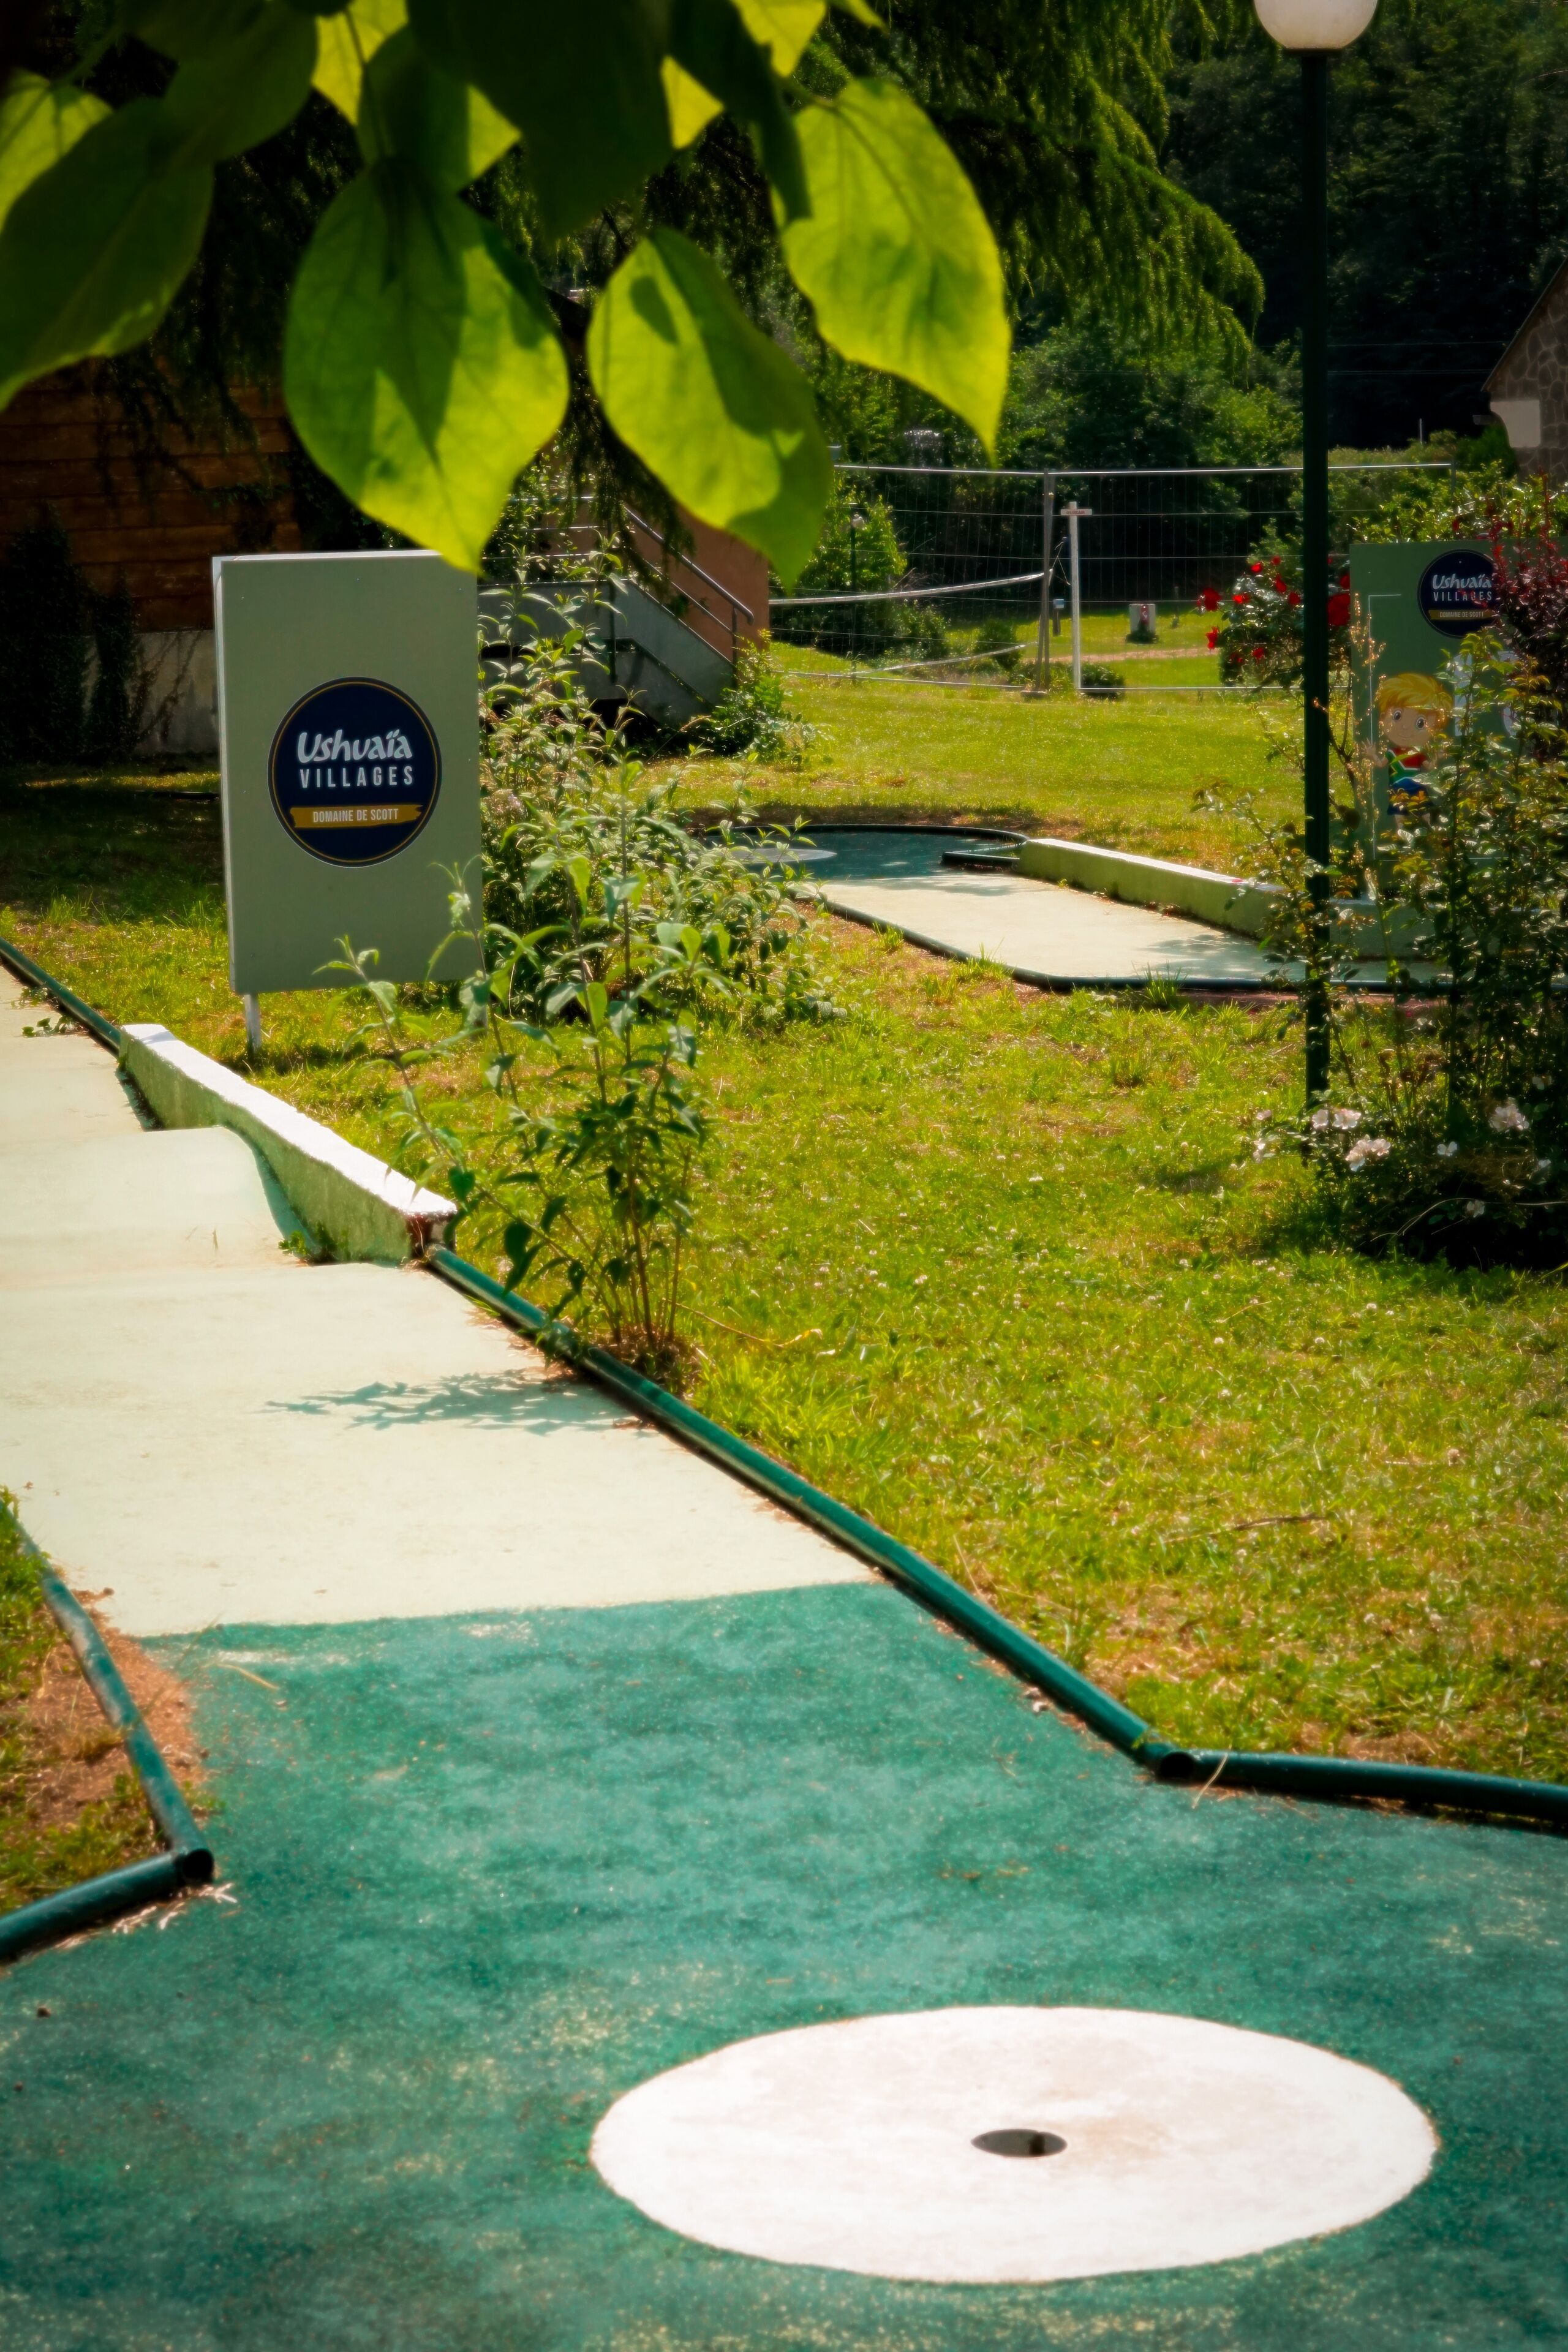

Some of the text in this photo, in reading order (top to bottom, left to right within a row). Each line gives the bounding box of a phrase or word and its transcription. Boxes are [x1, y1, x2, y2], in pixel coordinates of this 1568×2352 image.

[1432, 574, 1492, 589] Ushuaïa
[1433, 591, 1492, 601] VILLAGES
[298, 729, 413, 763] Ushuaïa
[300, 766, 413, 788] VILLAGES
[313, 809, 399, 823] DOMAINE DE SCOTT
